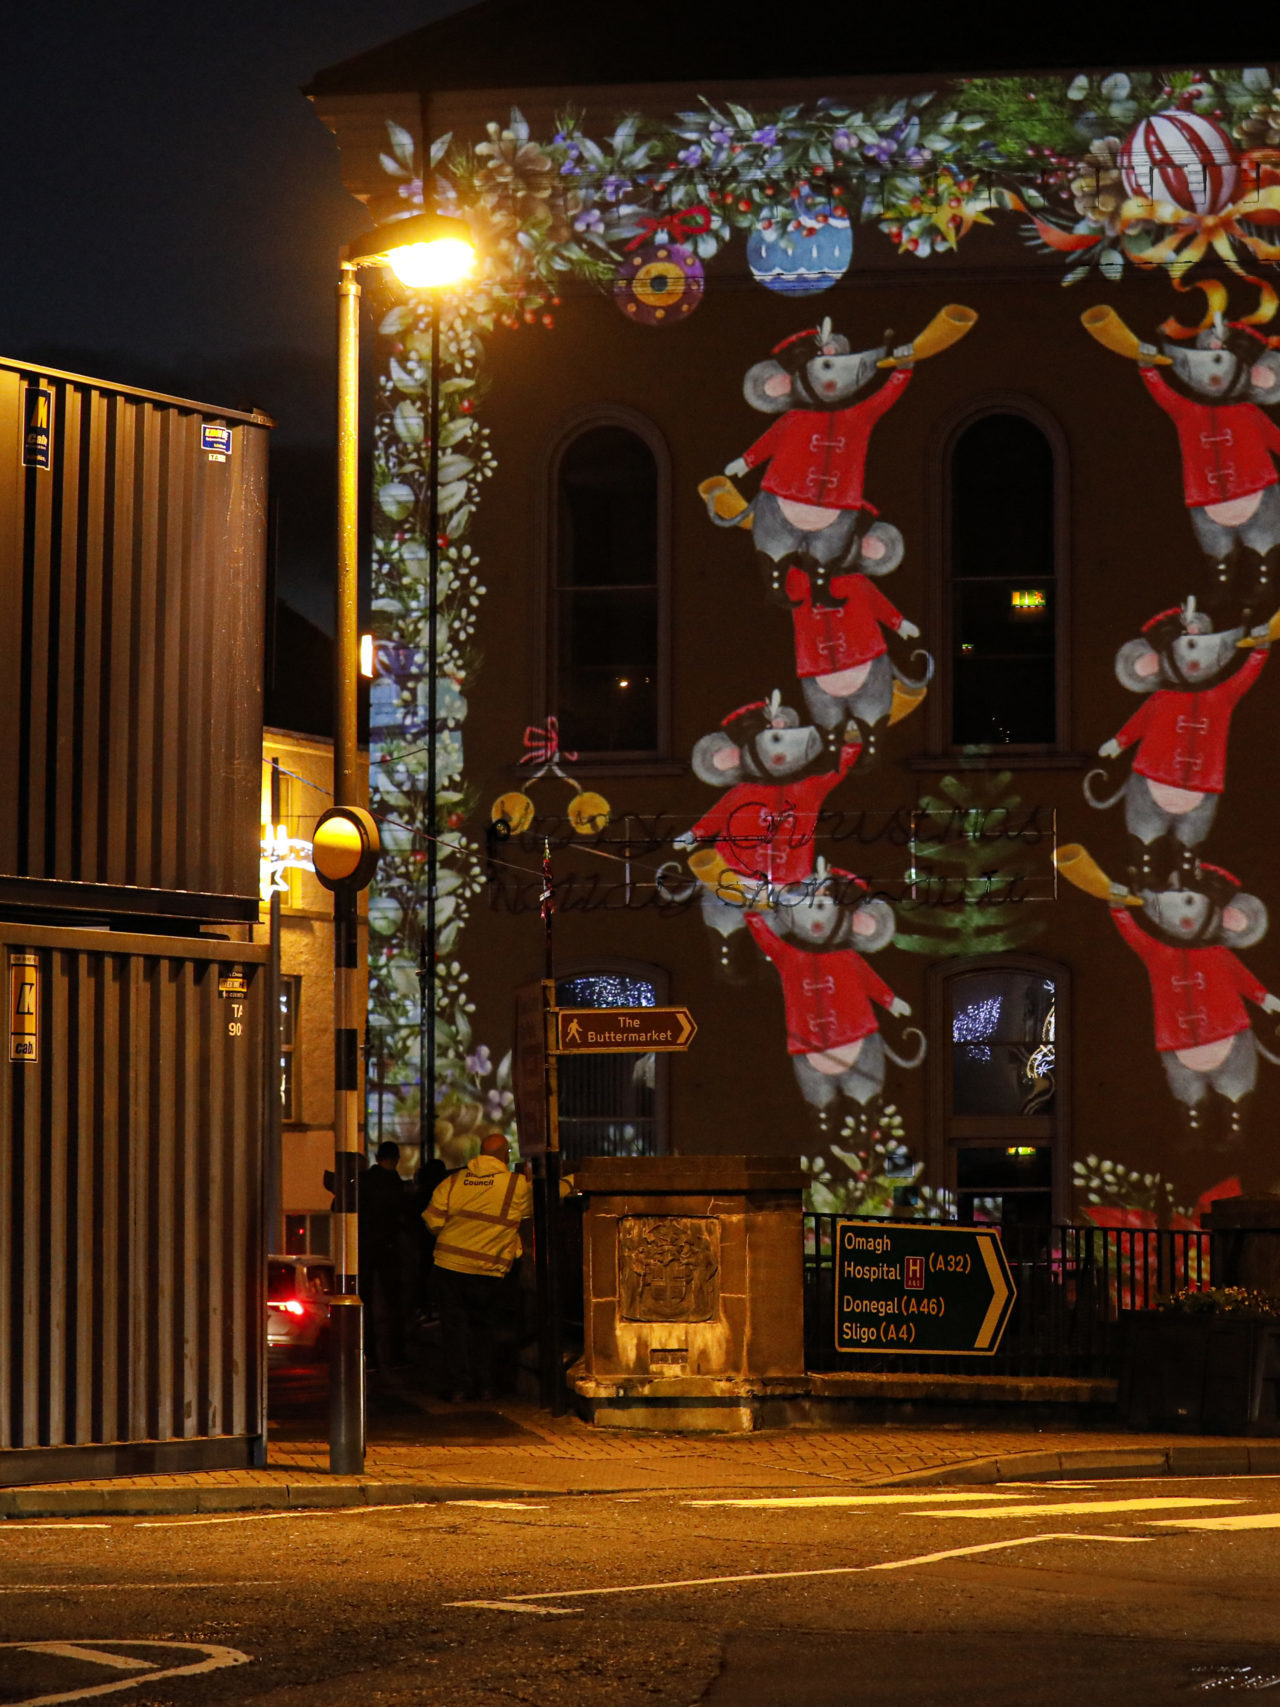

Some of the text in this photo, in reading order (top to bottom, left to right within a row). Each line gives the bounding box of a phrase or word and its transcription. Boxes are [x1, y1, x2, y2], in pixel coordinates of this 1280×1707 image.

[617, 1016, 641, 1028] The
[587, 1029, 672, 1042] Buttermarket
[844, 1232, 891, 1254] Omagh
[844, 1261, 901, 1282] Hospital
[929, 1252, 971, 1274] (A32)
[843, 1295, 945, 1317] Donegal (A46)
[842, 1321, 915, 1343] Sligo (A4)
